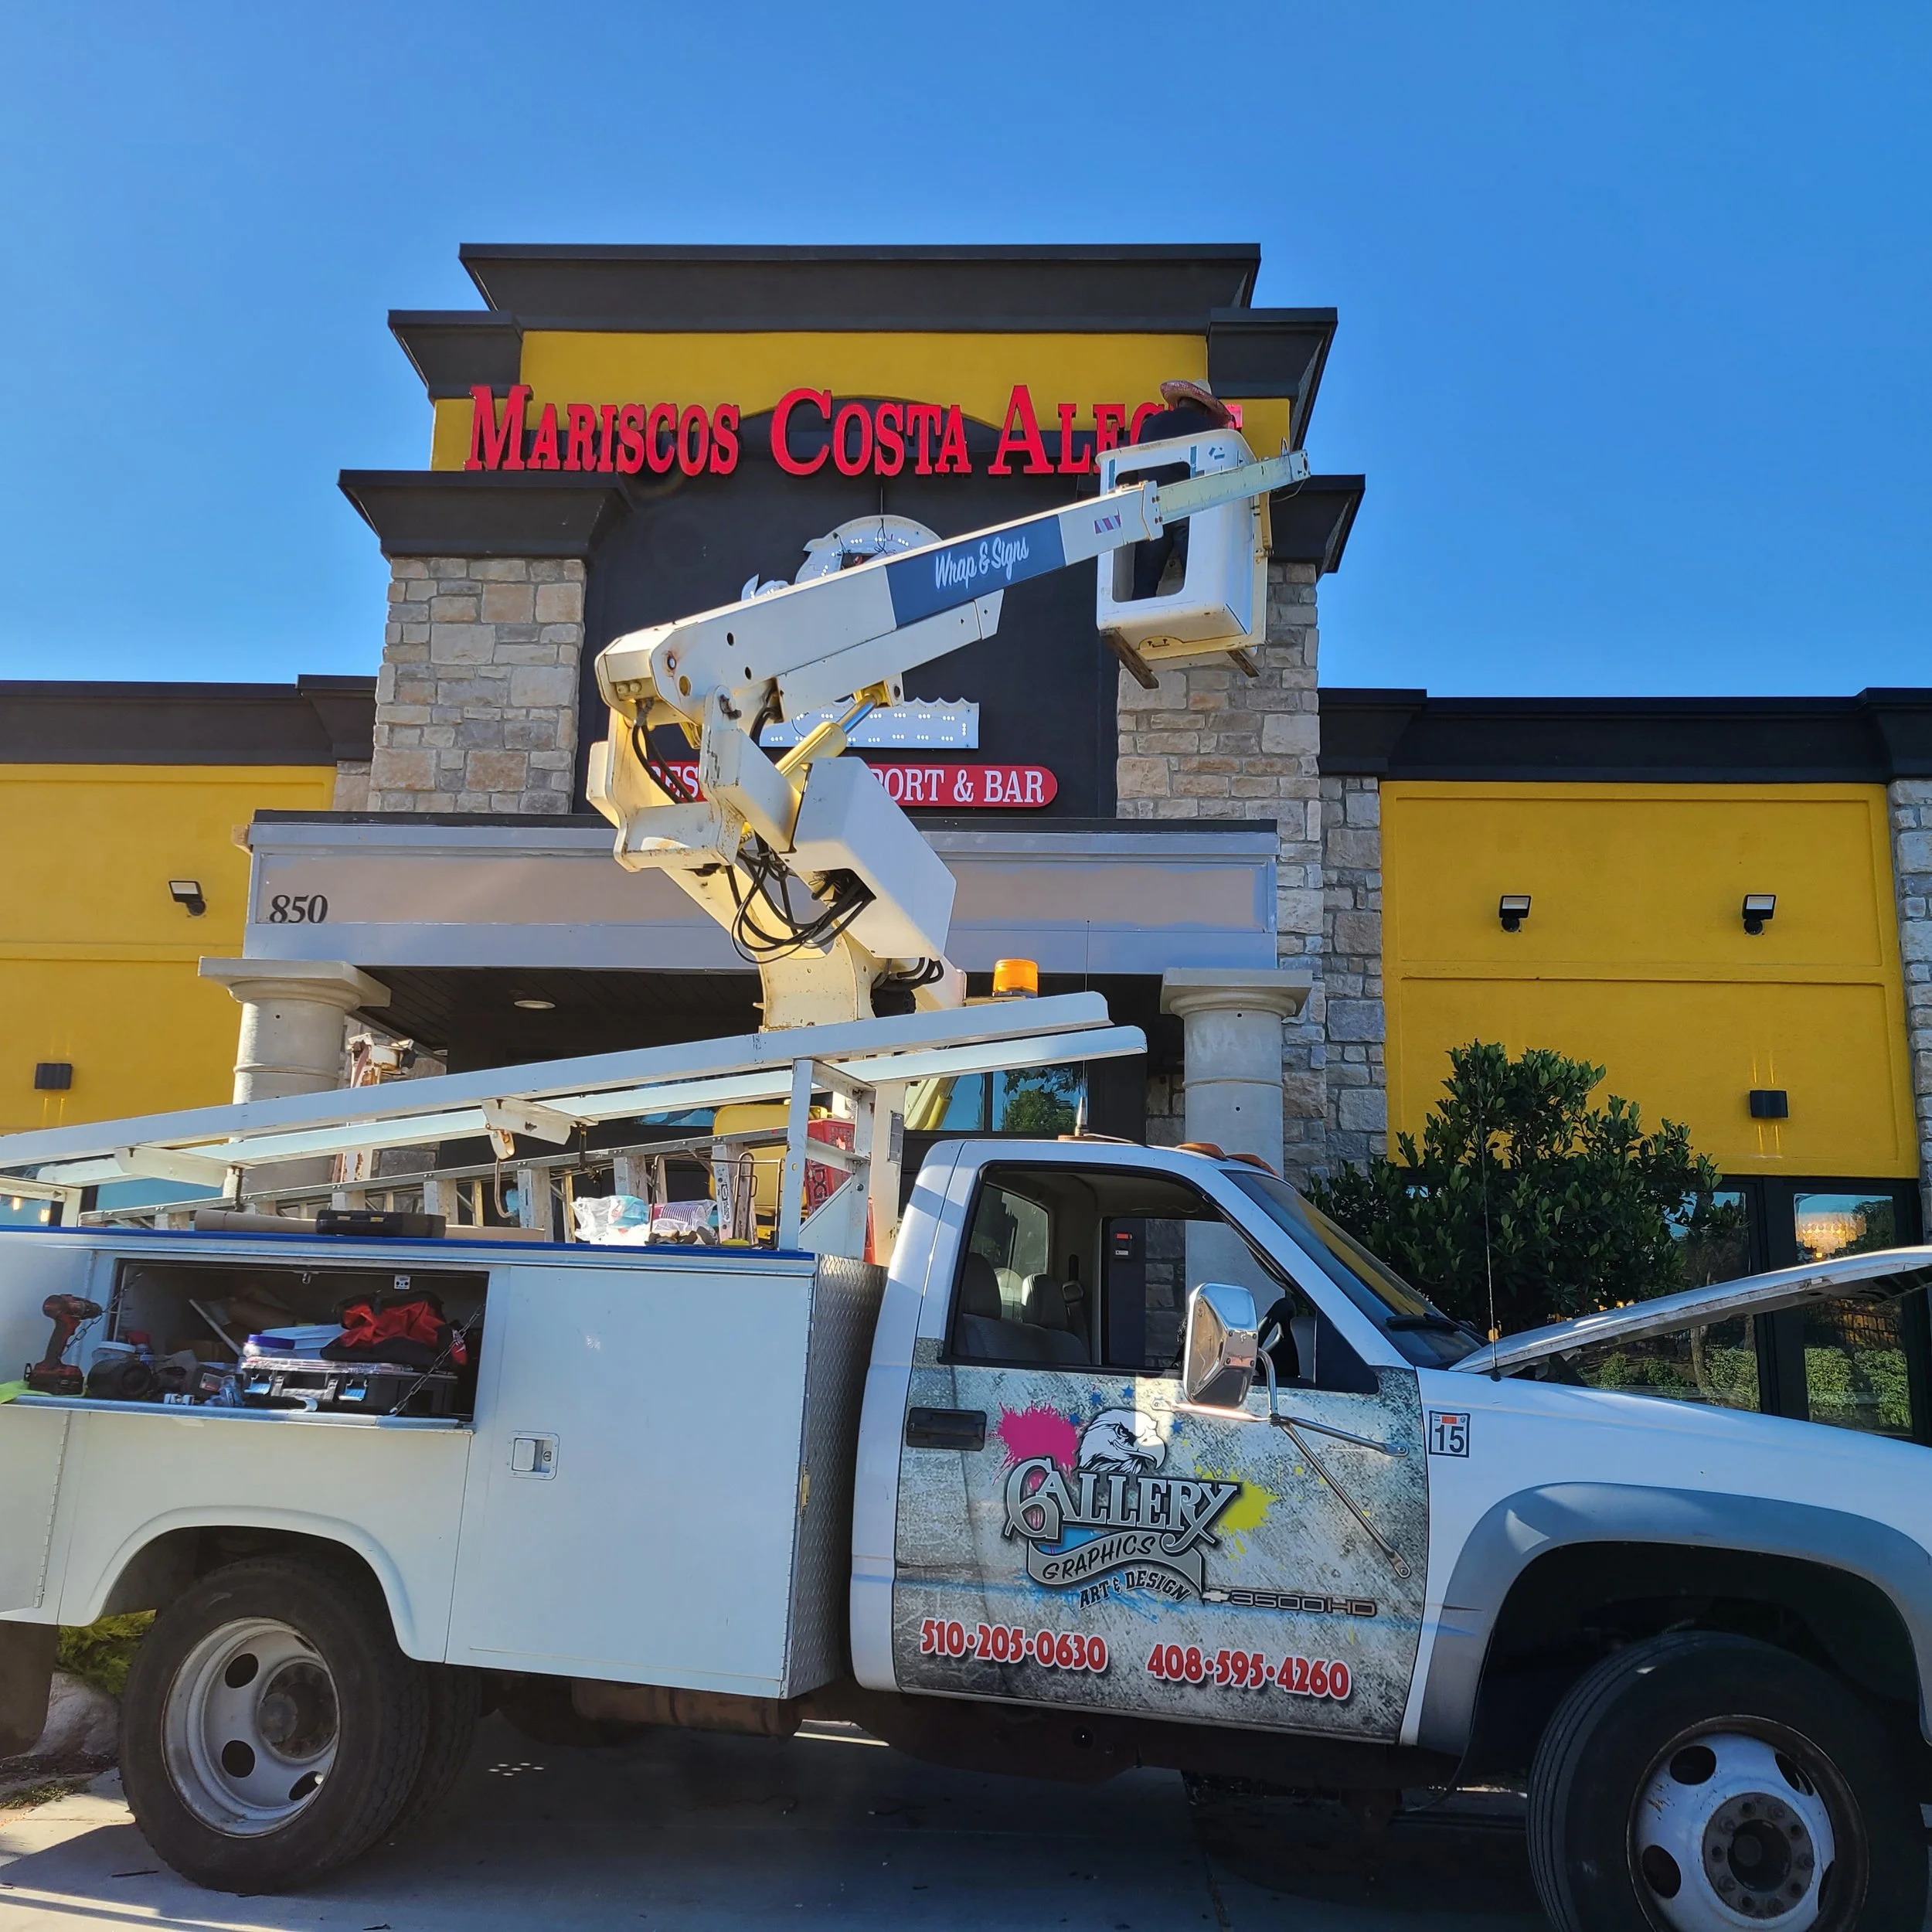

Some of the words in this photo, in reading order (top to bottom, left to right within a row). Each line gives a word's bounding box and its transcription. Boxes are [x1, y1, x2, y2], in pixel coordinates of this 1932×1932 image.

[464, 384, 740, 476] MARISCOS
[770, 388, 972, 476] COSTA
[935, 551, 977, 590] Wrap
[978, 541, 991, 575] &
[991, 536, 1029, 581] Signs
[953, 769, 975, 802] &
[984, 770, 1045, 803] BAR
[269, 894, 328, 924] 850
[1434, 1424, 1464, 1453] 15
[1004, 1457, 1238, 1552] GALLERY
[1043, 1535, 1156, 1580] GRAPHICS
[1080, 1579, 1109, 1609] ART
[1112, 1577, 1121, 1593] &
[1124, 1570, 1191, 1601] DESIGN
[1230, 1590, 1376, 1617] 3500HD
